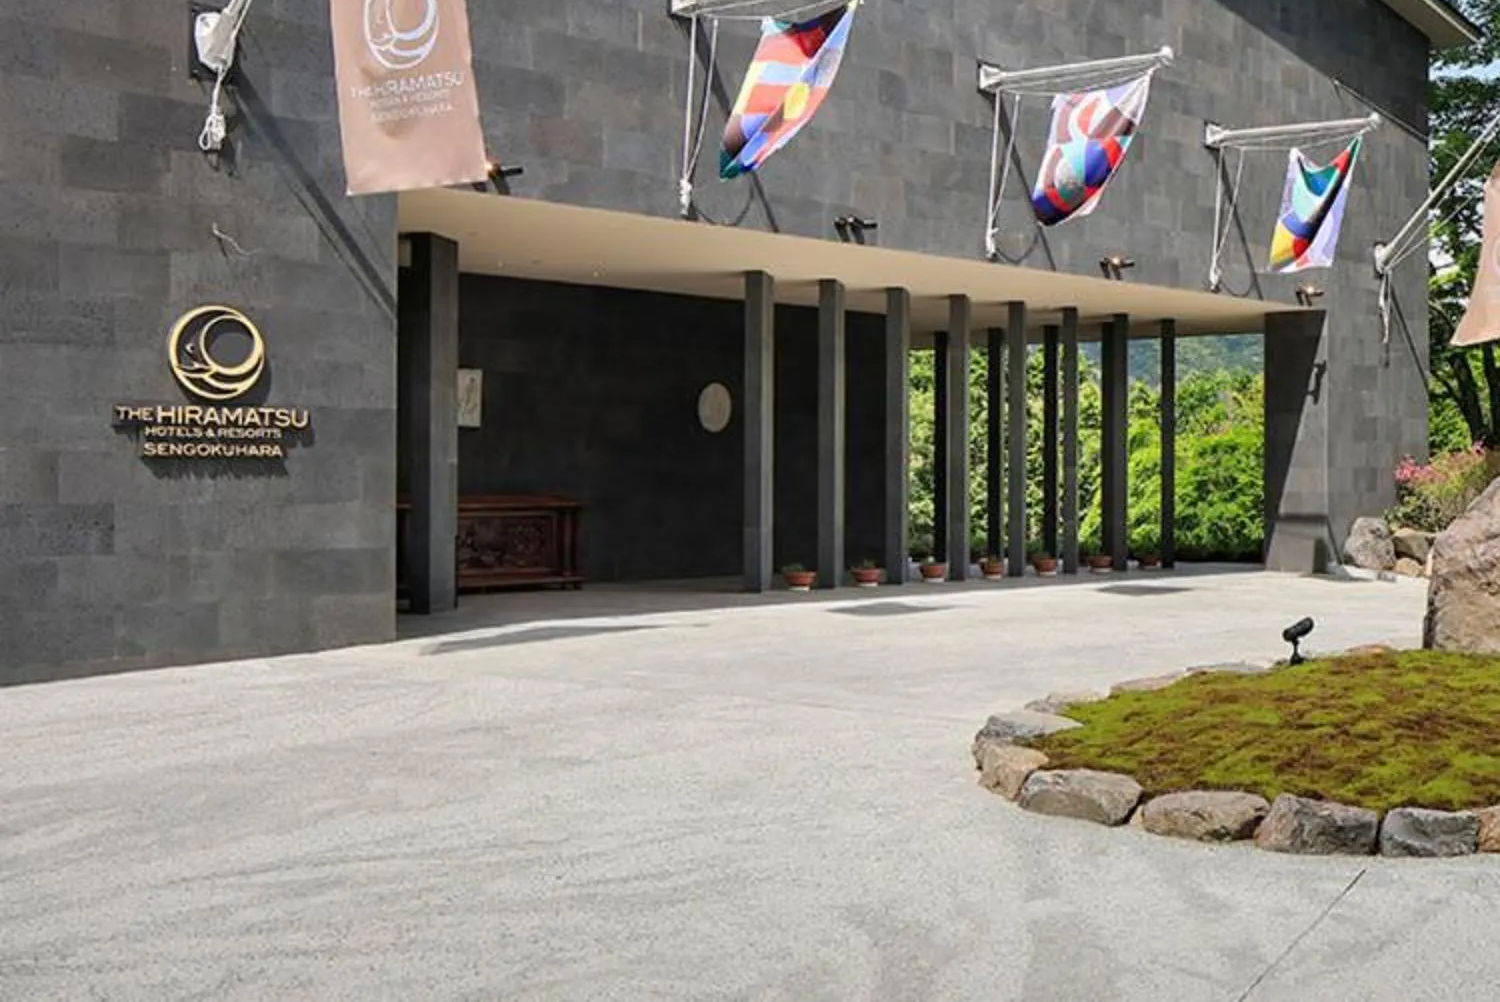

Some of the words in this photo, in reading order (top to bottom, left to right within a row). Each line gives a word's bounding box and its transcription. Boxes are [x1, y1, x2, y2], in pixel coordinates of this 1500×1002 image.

[115, 406, 153, 420] THE
[157, 406, 308, 428] HIRAMATSU
[145, 426, 202, 438] HOTELS
[206, 428, 215, 437] &
[144, 442, 282, 457] SENGOKUHARA
